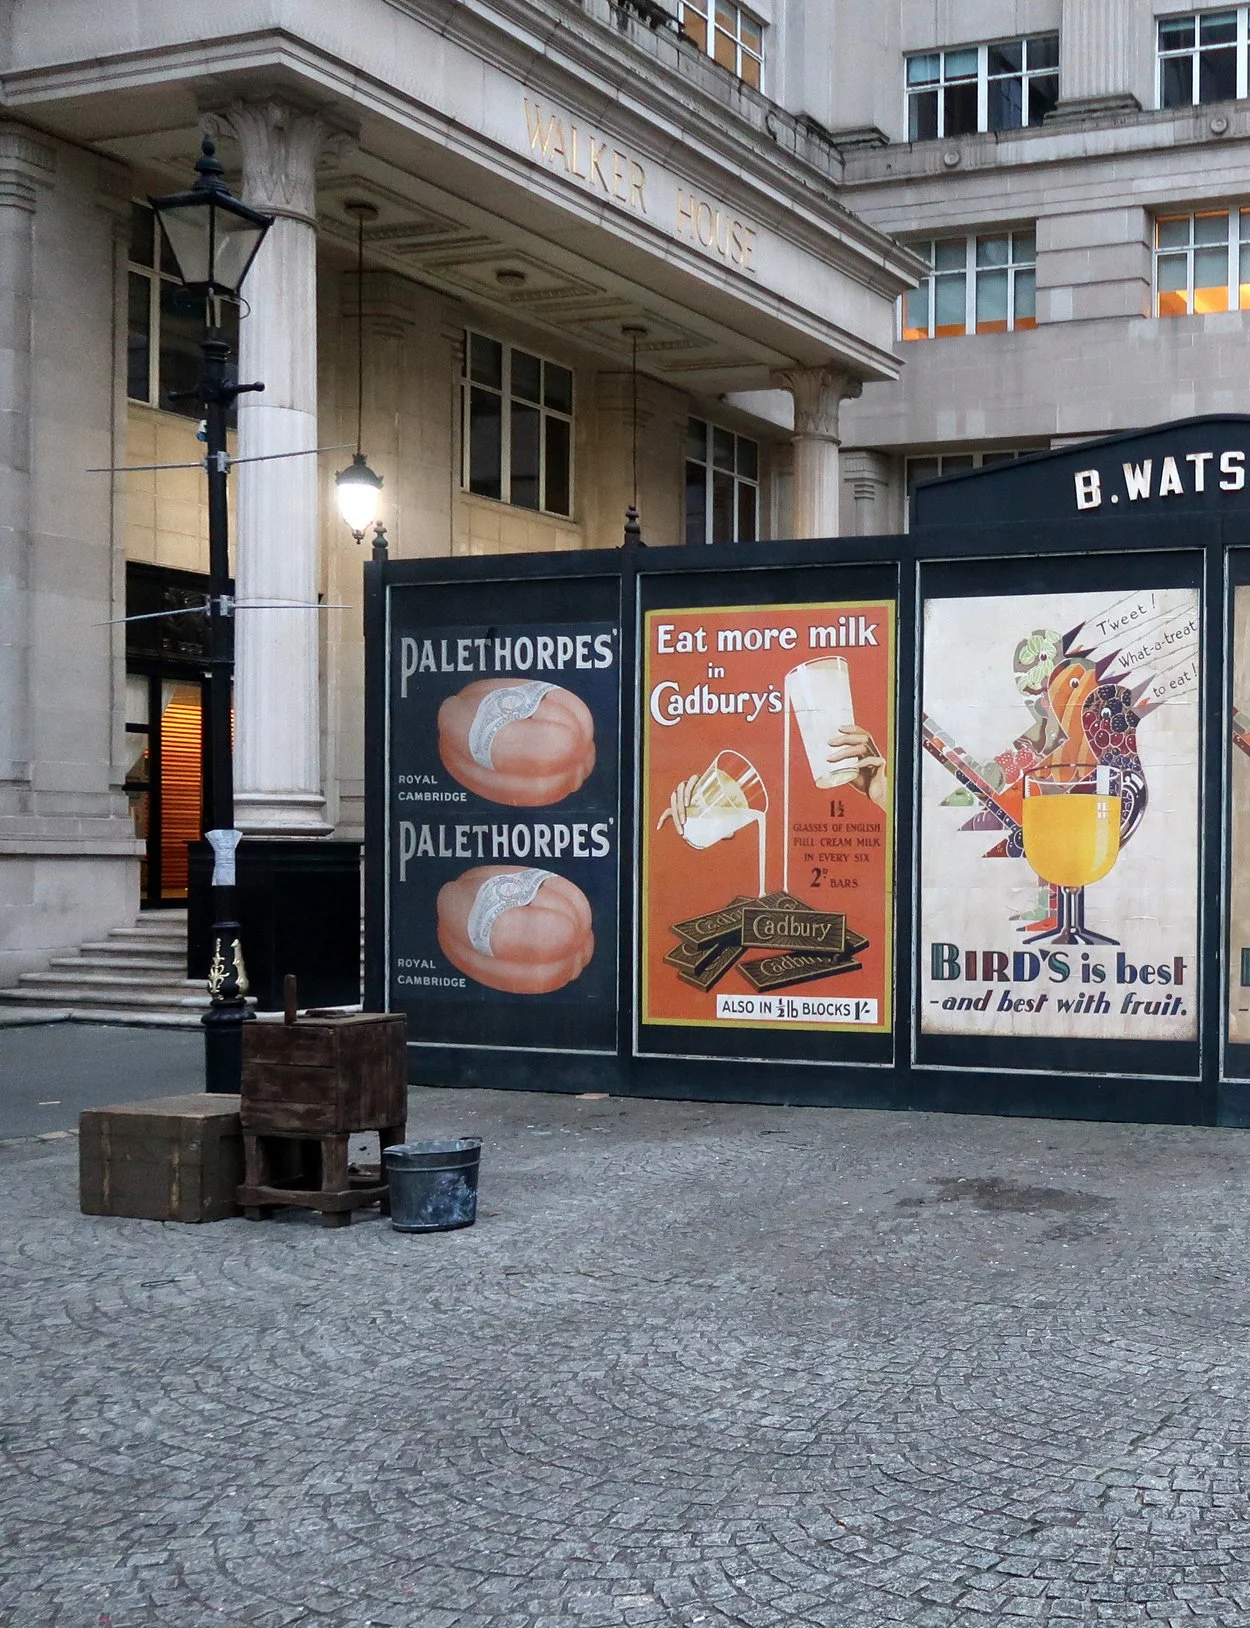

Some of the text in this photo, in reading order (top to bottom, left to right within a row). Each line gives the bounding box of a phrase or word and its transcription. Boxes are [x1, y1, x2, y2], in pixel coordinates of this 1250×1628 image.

[523, 97, 756, 273] WALKER HOUSE
[656, 616, 880, 654] Eat more milk
[401, 628, 617, 698] PALETHORPES'
[707, 662, 726, 679] in
[1153, 686, 1166, 698] to
[650, 681, 783, 726] Cadbury's
[398, 775, 438, 784] ROYAL
[398, 791, 467, 802] CAMBRIDGE
[793, 823, 881, 833] GLASSES OF ENGLISH
[399, 817, 614, 882] PALETHORPES'
[793, 838, 881, 847] FULL CREAM MILK
[804, 853, 870, 862] IN EVERY SIX
[830, 879, 858, 888] BARS
[752, 914, 832, 942] Cadbury
[398, 959, 436, 969] ROYAL
[931, 942, 1188, 986] BIRD'S is best
[397, 975, 466, 988] CAMBRIDGE
[721, 1000, 755, 1014] ALSO
[759, 1001, 772, 1014] IN
[802, 1002, 850, 1017] BLOCKS
[996, 989, 1048, 1013] best
[1056, 991, 1111, 1014] with
[1120, 991, 1188, 1016] fruit.
